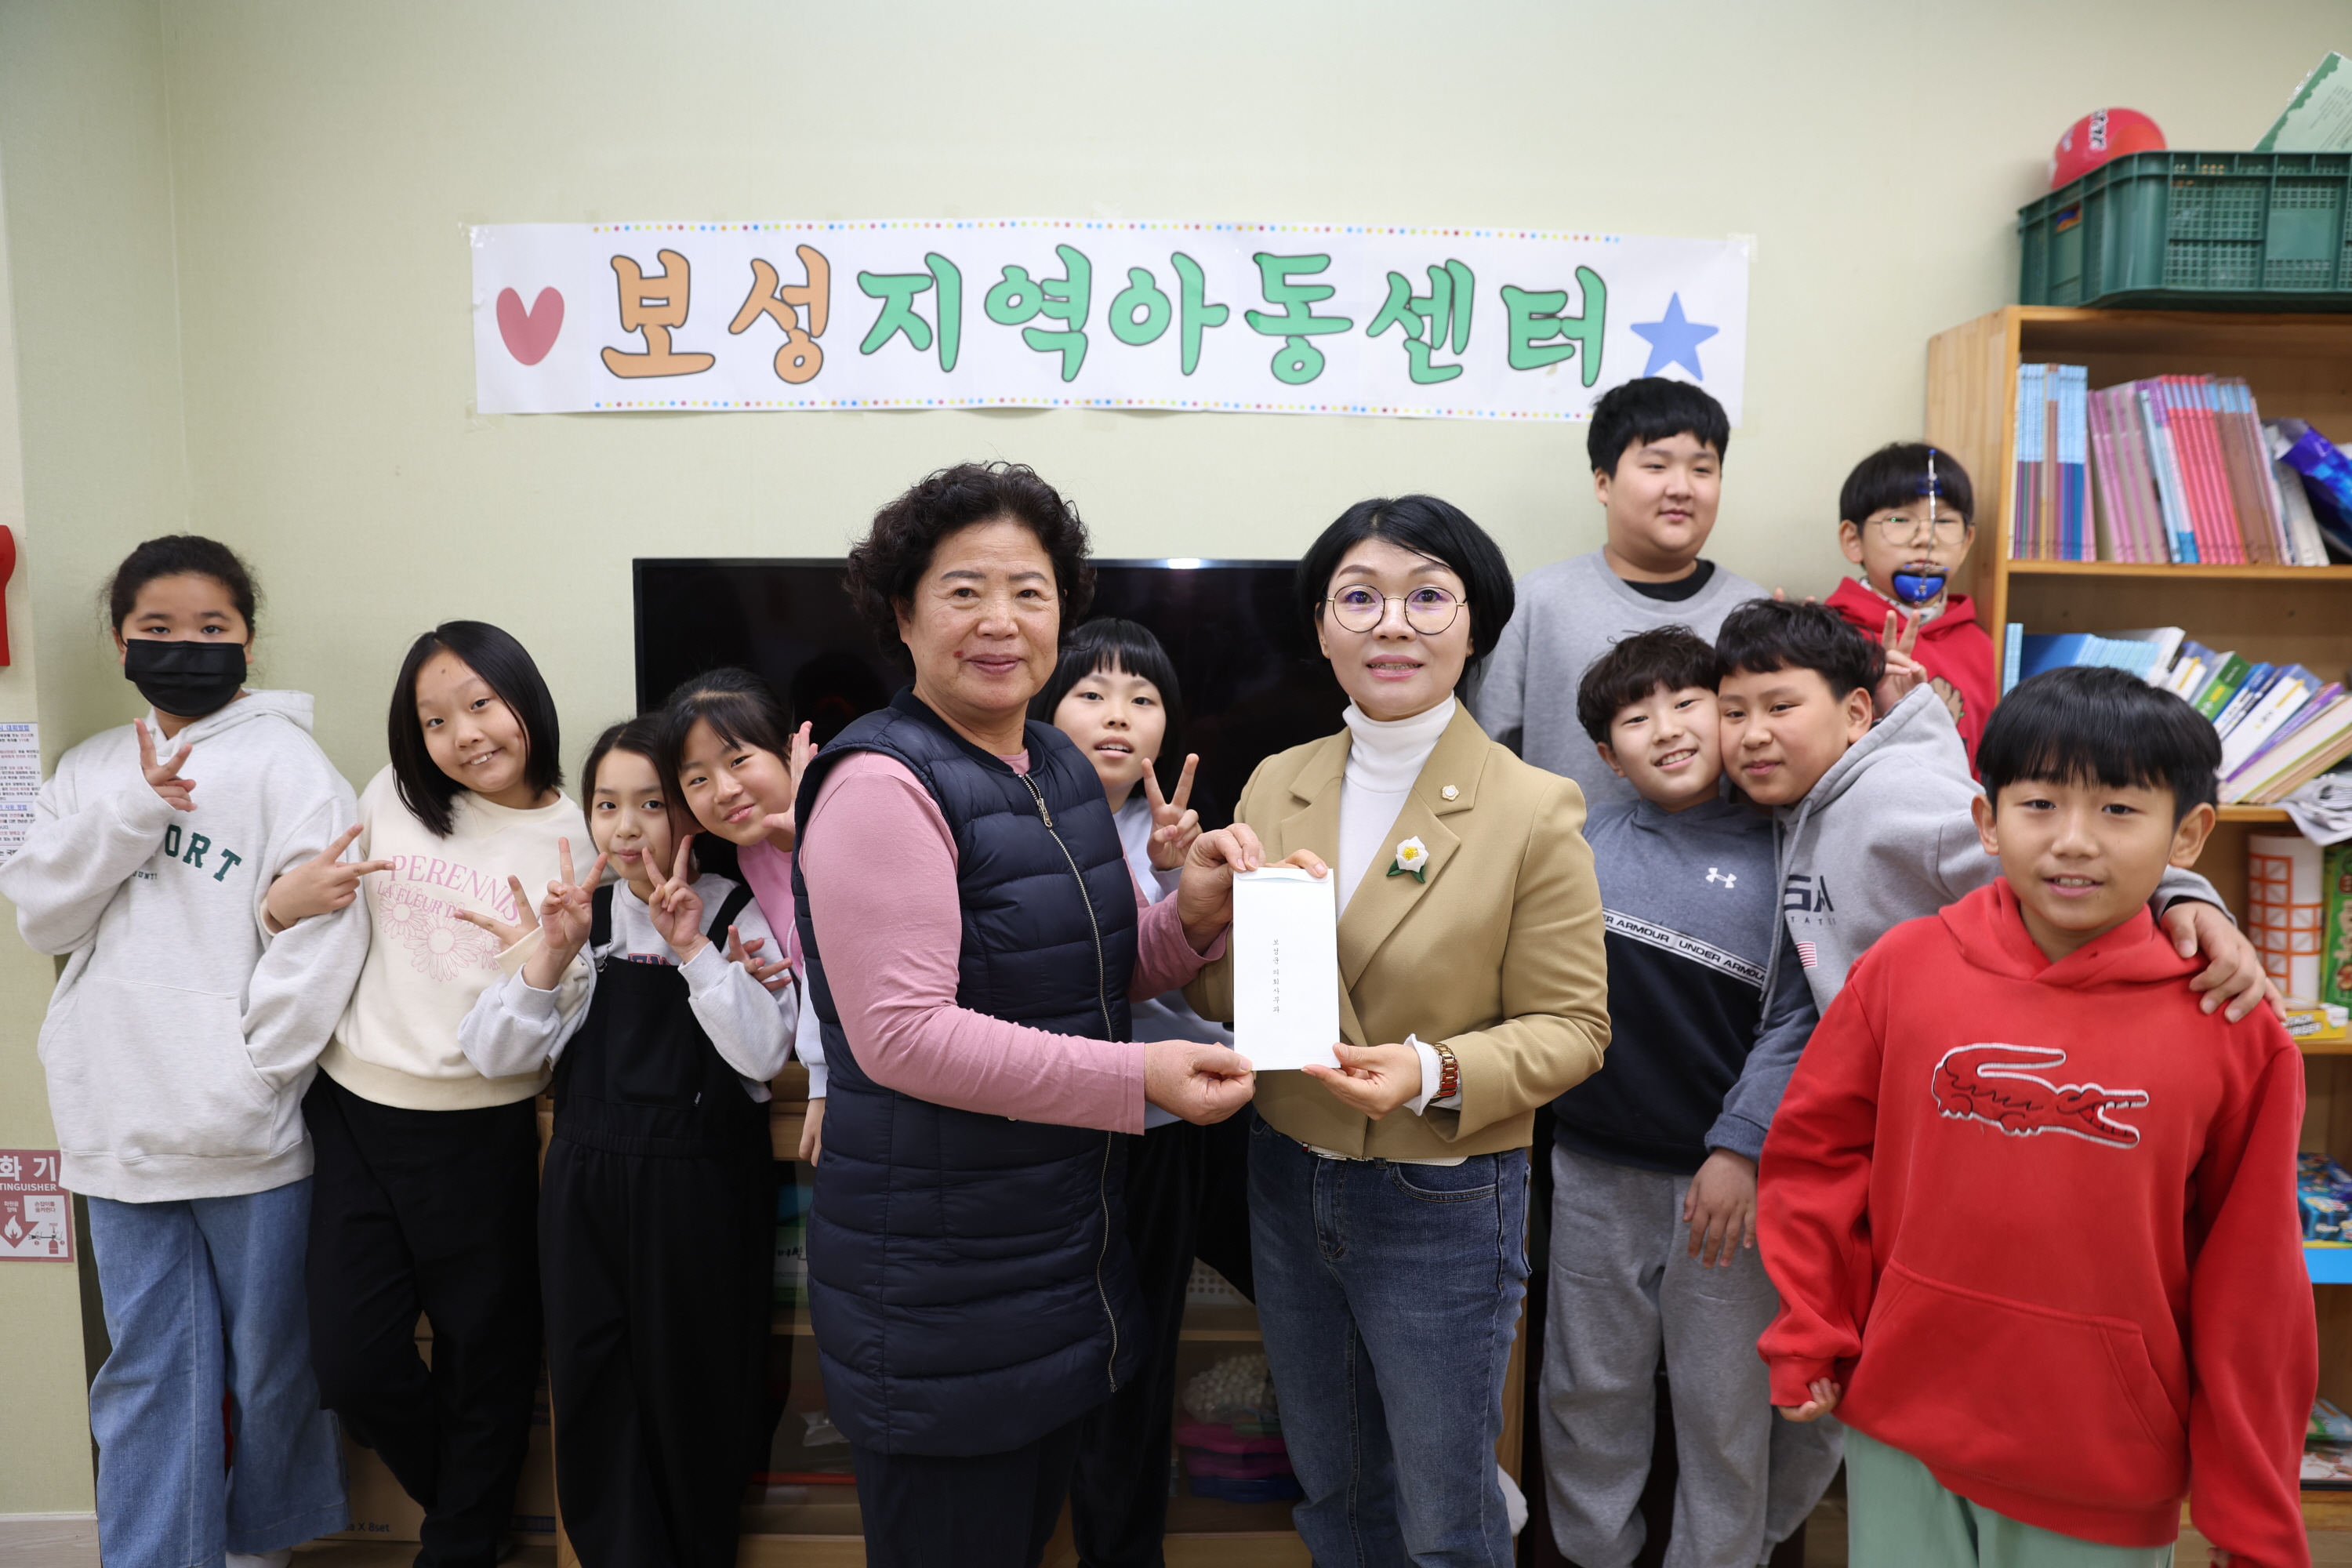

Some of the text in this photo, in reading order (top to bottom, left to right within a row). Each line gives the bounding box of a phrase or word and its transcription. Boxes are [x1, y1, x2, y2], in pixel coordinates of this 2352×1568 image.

[377, 880, 393, 899] LA
[396, 887, 443, 915] FLEUR
[390, 855, 519, 921] PERENNIS
[1616, 920, 1669, 943] ARMOUR
[1679, 940, 1721, 963] UNDER
[1723, 959, 1766, 982] ARMOU
[368, 1523, 390, 1532] 8set
